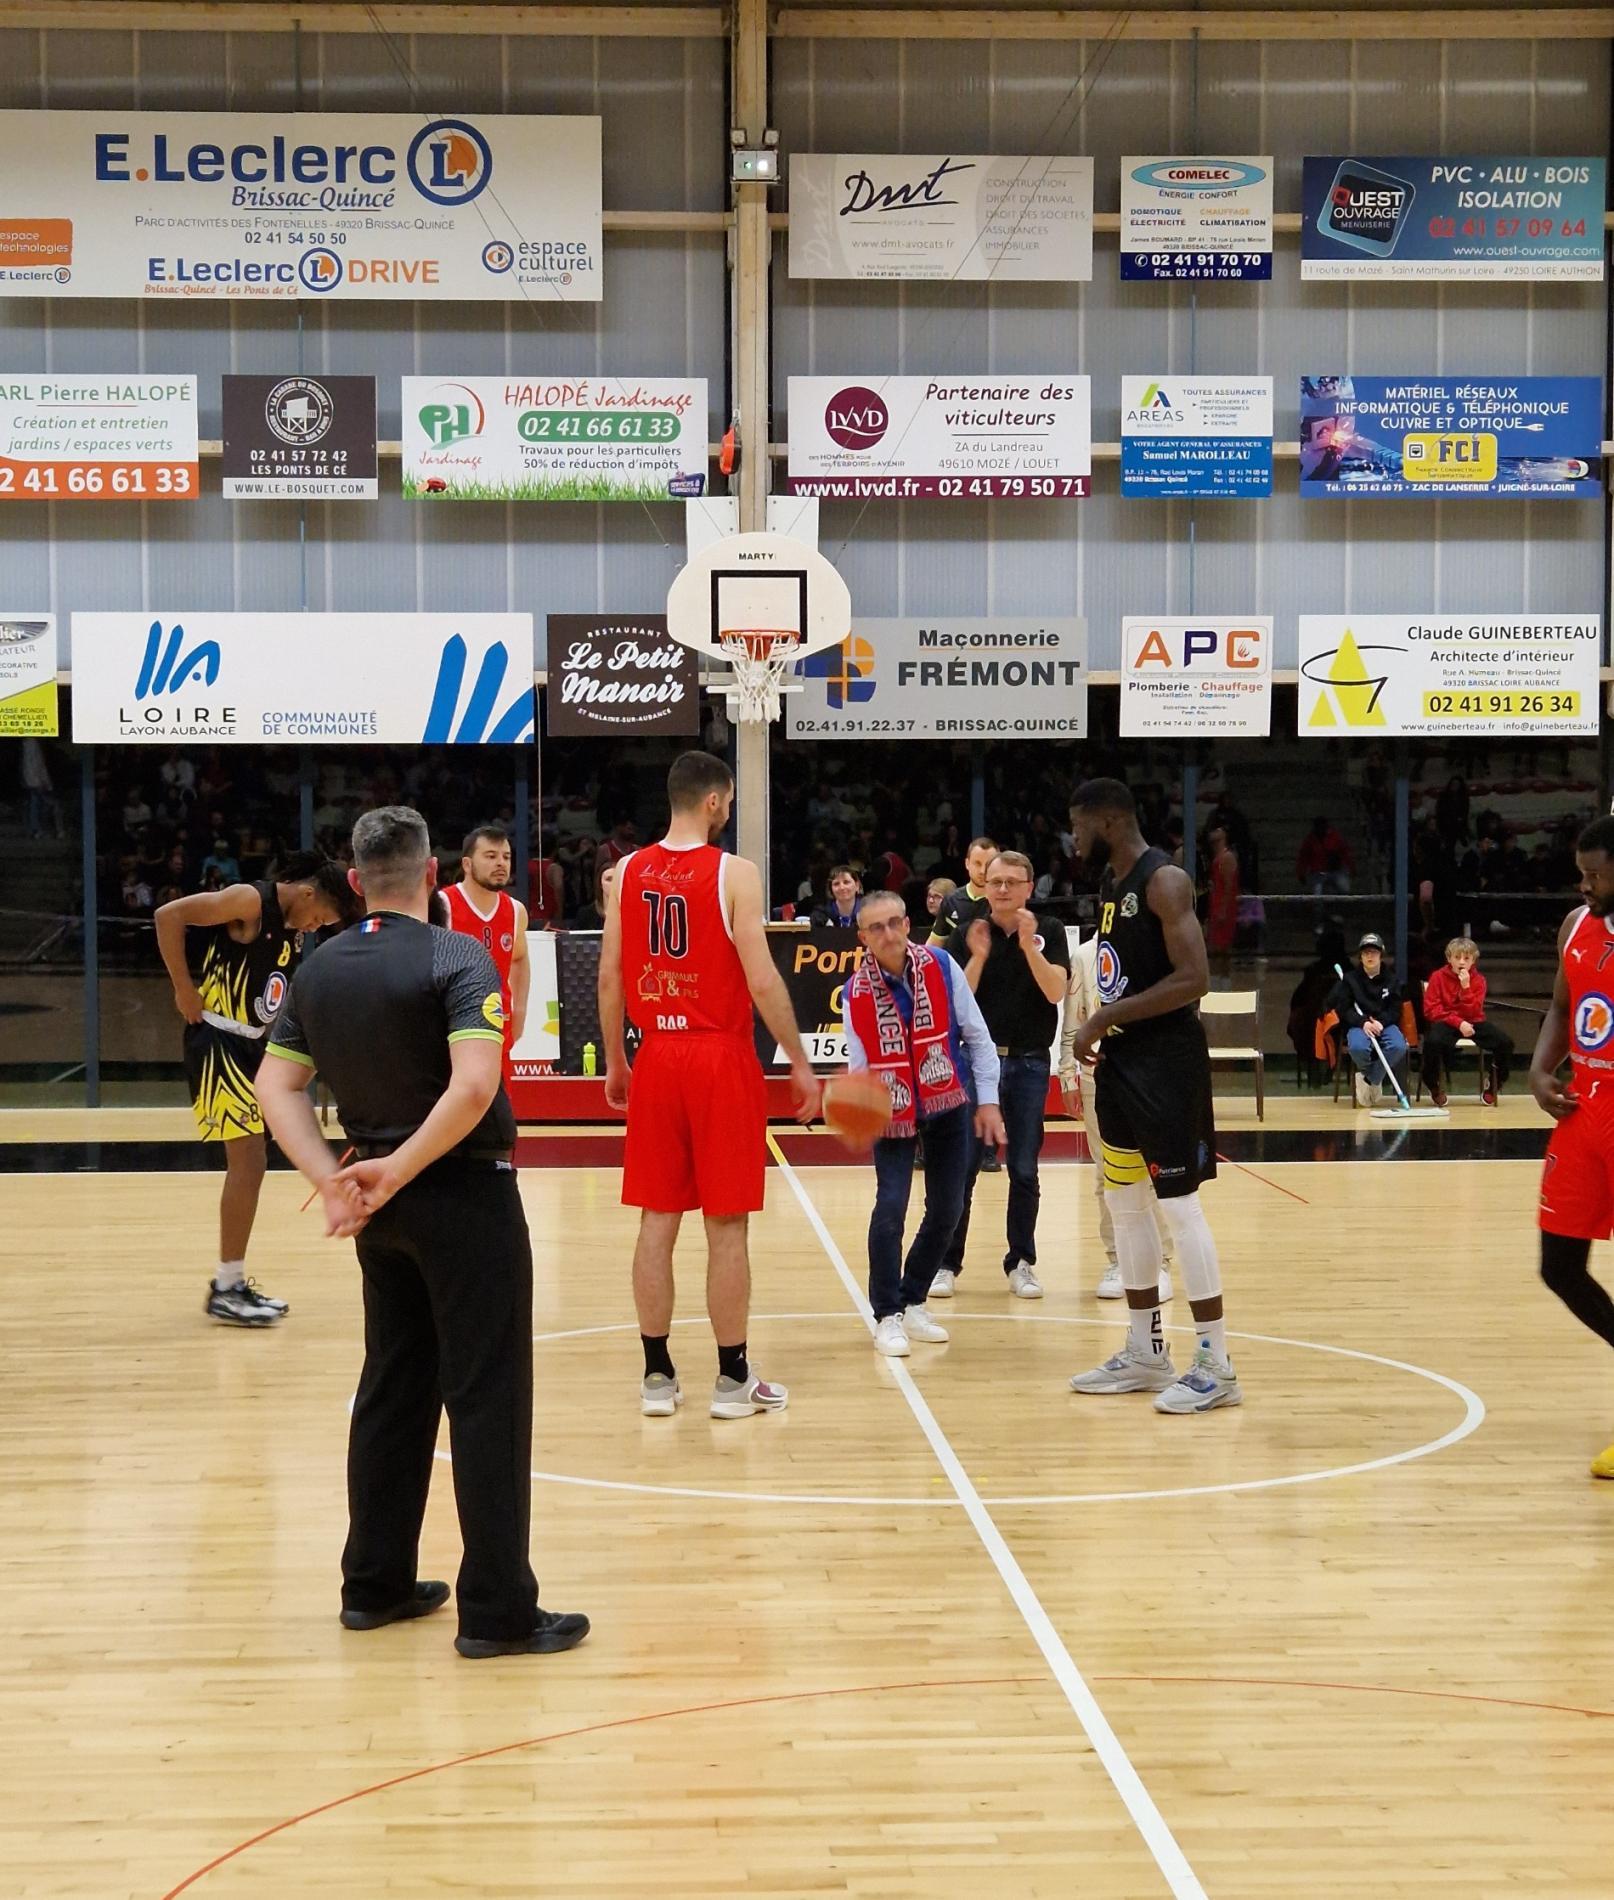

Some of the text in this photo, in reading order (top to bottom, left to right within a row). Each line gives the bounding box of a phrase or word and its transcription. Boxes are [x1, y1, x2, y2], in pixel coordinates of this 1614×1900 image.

[96, 133, 395, 184] E.Leclerc
[1168, 170, 1230, 180] COMELEC
[1431, 167, 1590, 184] PVC ALU BOIS
[985, 179, 1067, 188] CONSTRUCTION
[232, 186, 396, 212] Brissac-Quincé
[1458, 191, 1562, 209] ISOLATION
[1130, 208, 1182, 216] DOMOTIQUE
[1333, 207, 1400, 219] OUVRAGE
[135, 216, 328, 229] PARC DES FONTENELLES
[1200, 218, 1267, 226] CLIMATISATION
[1341, 221, 1391, 229] MENUISERIE
[1429, 217, 1586, 238] 02 41 57 09 64
[245, 232, 346, 244] 02 41 54 50 50
[519, 242, 587, 258] espace
[519, 256, 594, 270] culturel
[1152, 254, 1261, 265] 02 41 91 70 70
[149, 258, 440, 283] E.Leclerc DRIVE
[1154, 268, 1228, 277] Fax. 02 41 91 70
[40, 382, 191, 401] Pierre HALOPÉ
[504, 381, 693, 416] HALOPÉ Jardinage
[926, 383, 1074, 401] Partenaire des
[1386, 384, 1518, 399] MATÉRIEL RÉSEAUX
[1335, 400, 1569, 415] INFORMATIQUE & TÉLÉPHONIQUE
[13, 415, 169, 429] Création et entretien
[830, 407, 884, 428] LVVD
[945, 408, 1056, 426] viticulteurs
[1127, 411, 1184, 421] AREAS
[1380, 417, 1522, 429] CUIVRE ET OPTIQUE
[524, 417, 674, 437] 02 41 66 61 33
[7, 437, 173, 454] jardins espaces verts
[519, 445, 682, 458] Travaux pour les particuliers
[955, 441, 1043, 452] ZA du Landreau
[250, 450, 348, 462] 02 41 57 72 42
[1143, 451, 1251, 460] Samuel MAROLLEAU
[251, 462, 347, 475] LES PONTS DE CÉ
[524, 459, 679, 470] 50% de réduction d'impôts
[938, 458, 974, 469] 49610
[1023, 458, 1060, 469] LOUET
[23, 467, 190, 492] 41 66 61 33
[234, 482, 365, 494] WWW.LE-BOSQUET.COM
[795, 478, 1085, 497] www.lvvd.fr 02 41 79 50 71
[738, 552, 774, 560] MARTY
[587, 627, 661, 638] RESTAURANT
[919, 629, 1060, 650] Maçonnerie
[1407, 625, 1597, 640] Claude GUINEBERTEAU
[561, 641, 686, 671] Le Petit
[1134, 630, 1260, 668] APC
[1430, 649, 1575, 662] Architecte d'intérieur
[899, 656, 1080, 686] FRÉMONT
[561, 672, 685, 703] Manoir
[1128, 682, 1263, 693] Plomberie Chauffage
[1500, 679, 1522, 687] LOIRE
[1429, 696, 1573, 713] 02 41 91 26 34
[119, 708, 237, 723] LOIRE
[262, 709, 378, 723] COMMUNAUTÉ
[120, 726, 236, 736] LAYON AUBANCE
[263, 724, 378, 735] DE COMMUNES
[796, 717, 1079, 732] 02.41.91.22.37 BRISSAC-QUINCÉ
[1401, 721, 1598, 732] www.guineberteau.fr info@guineberteau.fr
[642, 890, 689, 958] 10
[1101, 902, 1116, 934] 13
[482, 926, 494, 951] 8
[277, 940, 291, 967] 8
[1597, 940, 1614, 972] 7
[666, 980, 680, 997] &
[812, 1038, 836, 1057] 15
[250, 1103, 260, 1123] 8
